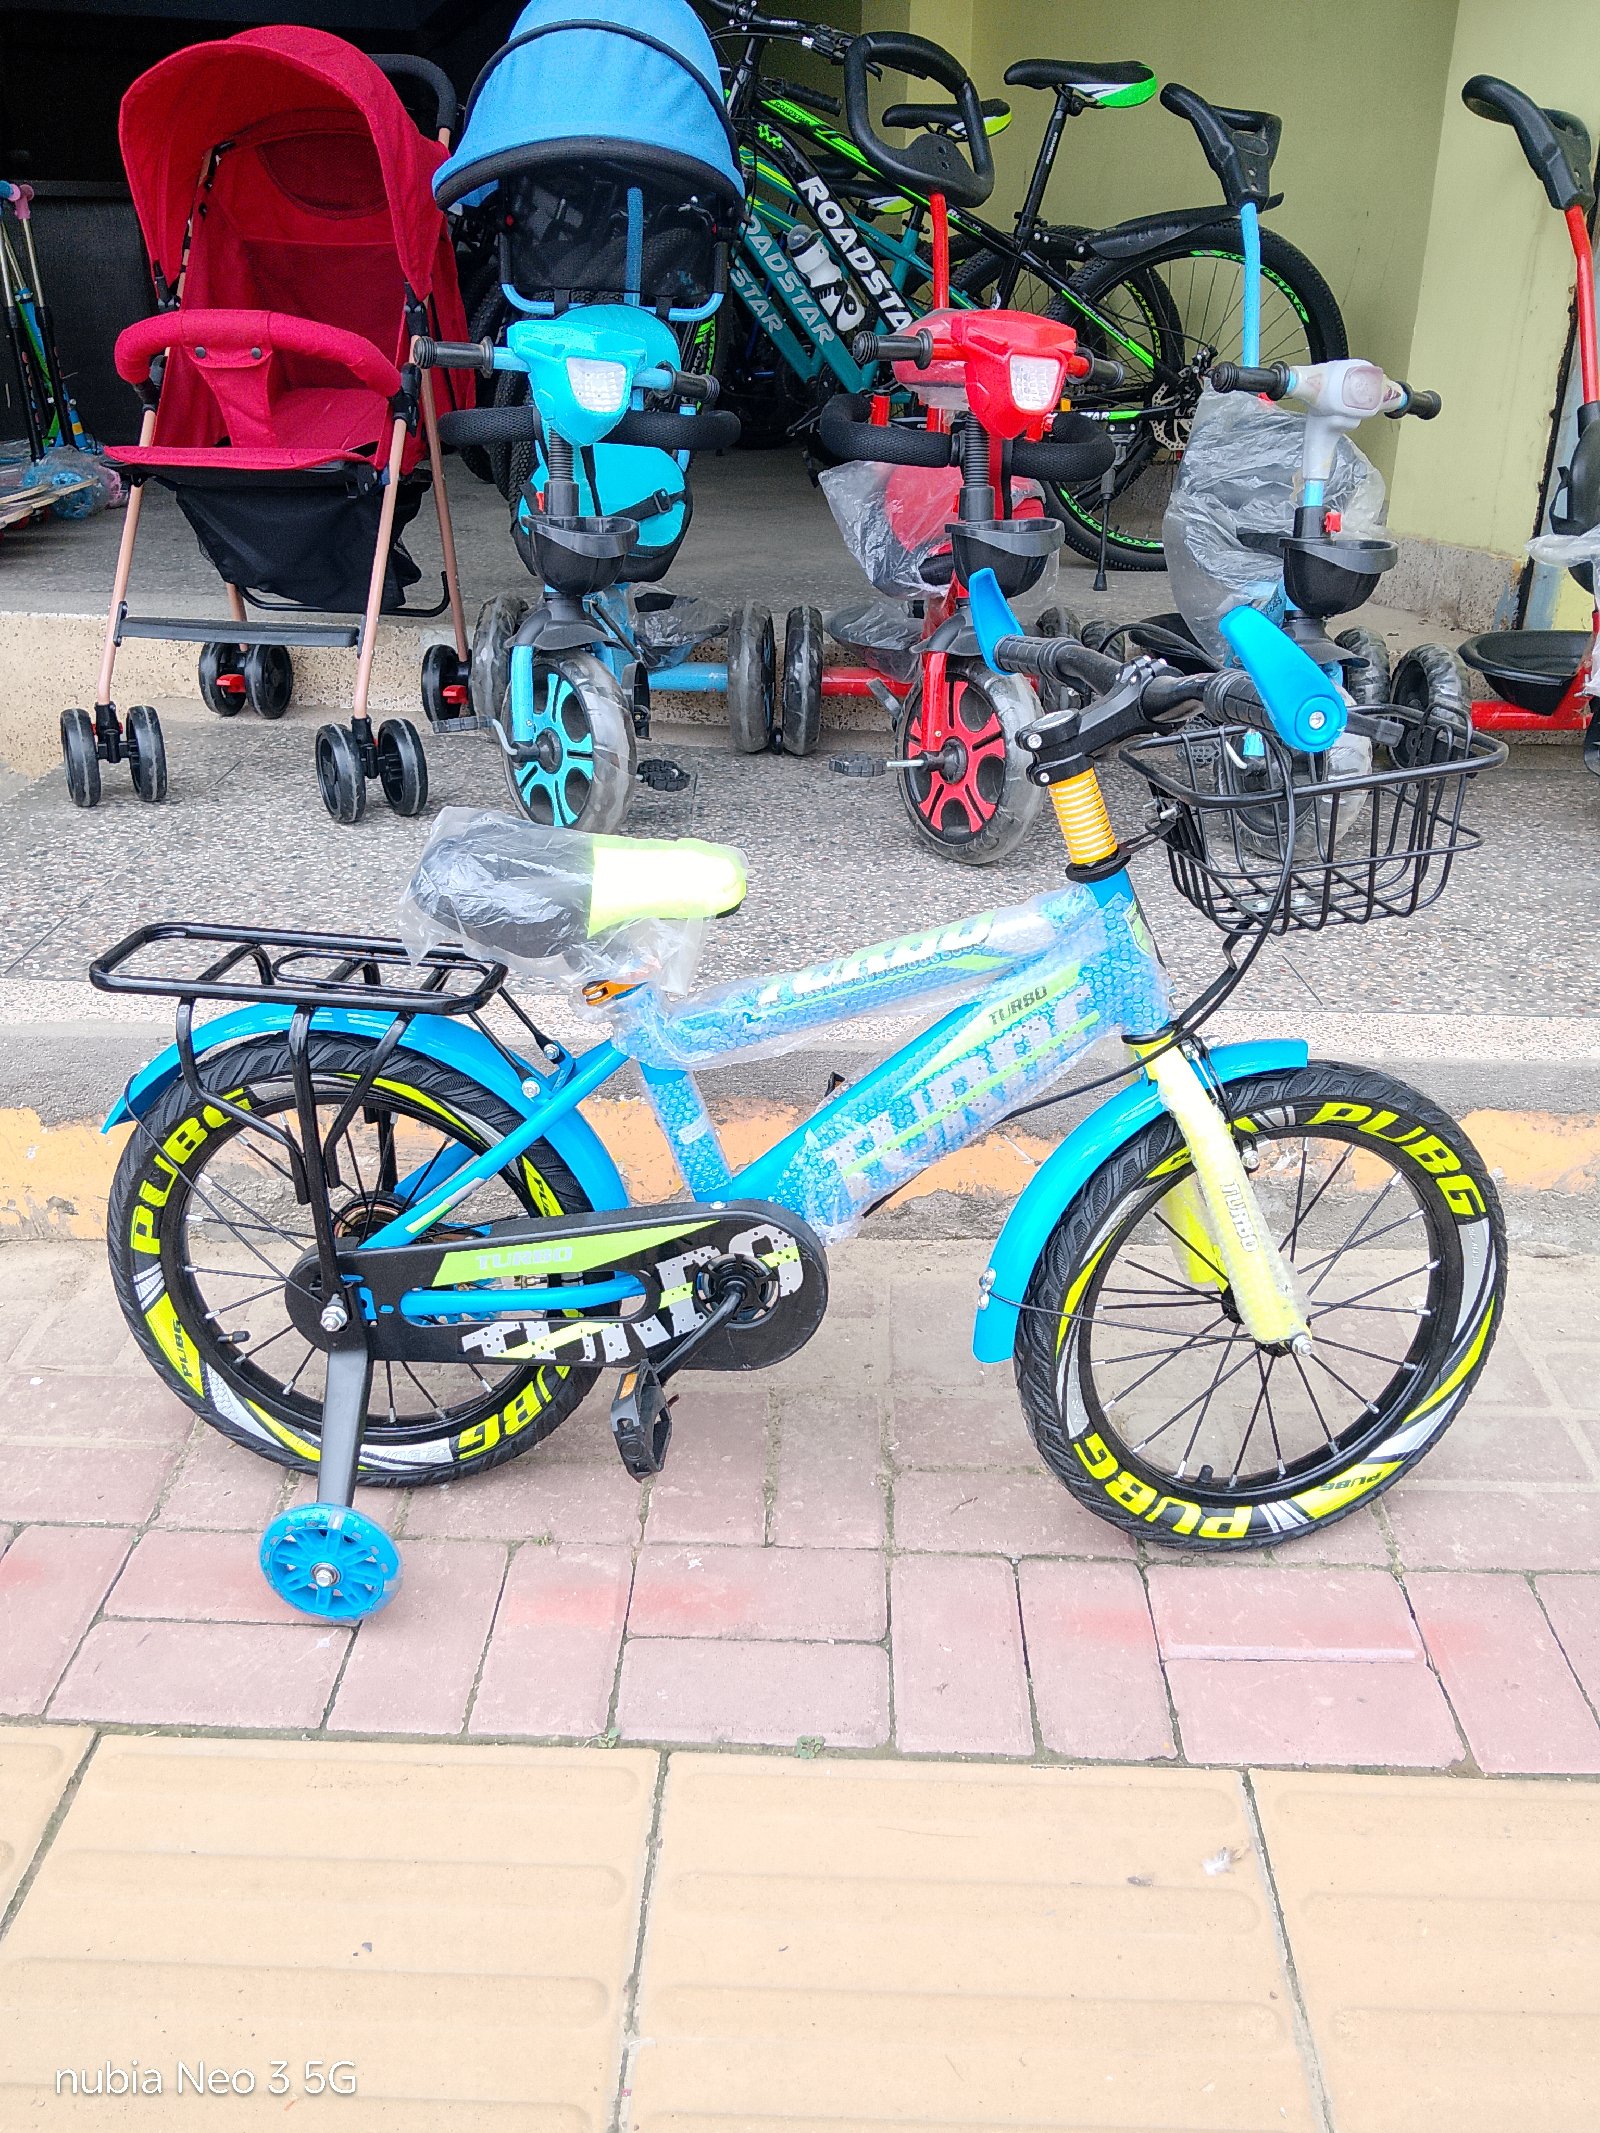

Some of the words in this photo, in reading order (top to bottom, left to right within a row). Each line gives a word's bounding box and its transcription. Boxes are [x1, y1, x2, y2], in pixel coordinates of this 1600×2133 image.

[742, 213, 835, 345] OADSTAR
[798, 176, 913, 331] ROADSTA
[730, 270, 783, 334] STAR
[990, 986, 1047, 1026] TURBO
[1304, 1102, 1487, 1216] PUBG
[1221, 1184, 1260, 1252] TURBO
[475, 1247, 573, 1271] TURBO
[172, 1318, 192, 1377] PUBG
[1073, 1436, 1252, 1539] PUBG
[1319, 1472, 1383, 1492] PUBG
